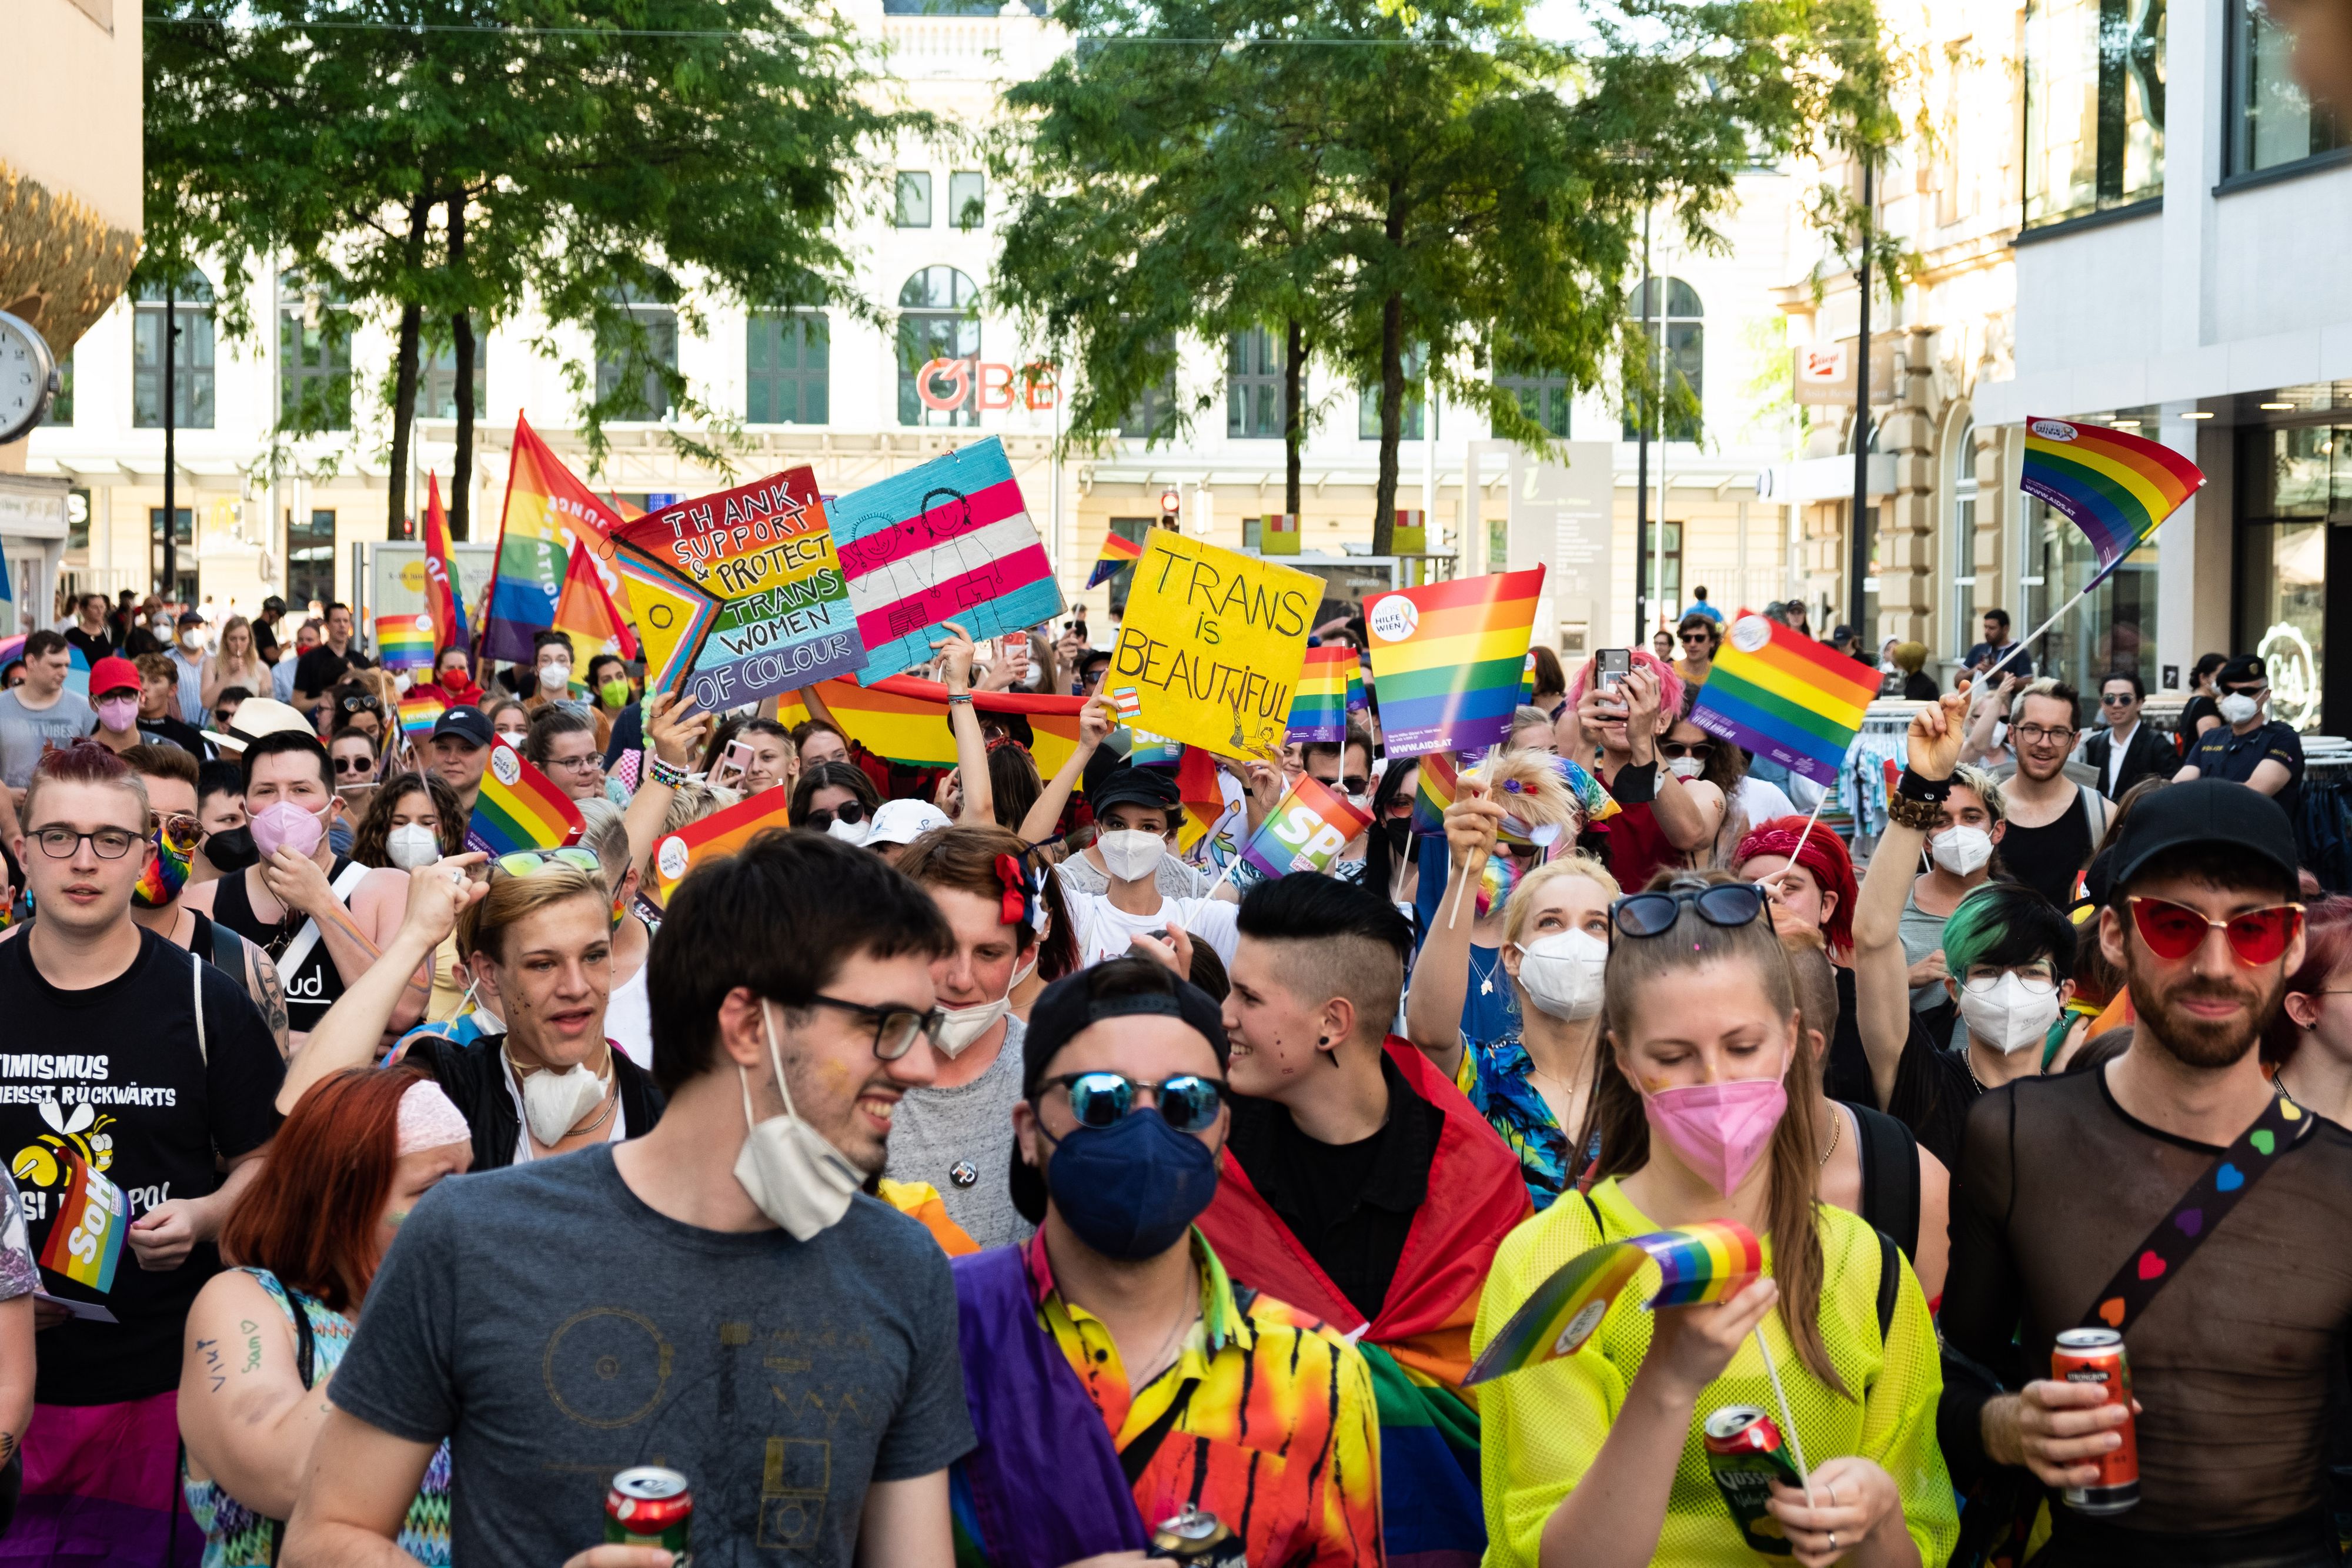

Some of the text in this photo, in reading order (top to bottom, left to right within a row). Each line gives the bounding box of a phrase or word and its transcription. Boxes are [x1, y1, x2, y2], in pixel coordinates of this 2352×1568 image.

[663, 482, 799, 537] THANK
[2024, 484, 2076, 517] WWW.AIDS.AT
[673, 507, 810, 565] SUPPORT
[693, 532, 830, 594] & PROTECT
[724, 568, 838, 626] TRANS
[1154, 546, 1308, 638] TRANS
[1345, 577, 1380, 588] zalando
[1374, 604, 1400, 616] AIDS
[1375, 613, 1401, 624] HILFE
[720, 602, 830, 656] WOMEN
[1376, 621, 1402, 633] WIEN
[694, 634, 853, 710] OF COLOUR
[2267, 653, 2307, 703] C&A
[44, 724, 74, 737] VIBES
[1389, 738, 1452, 754] WWW.AIDS.AT
[286, 964, 322, 997] ud
[0, 1053, 109, 1081] IMISMUS
[62, 1081, 177, 1107] RÜCKWÄRTS
[2066, 1372, 2110, 1382] STRONGBOW
